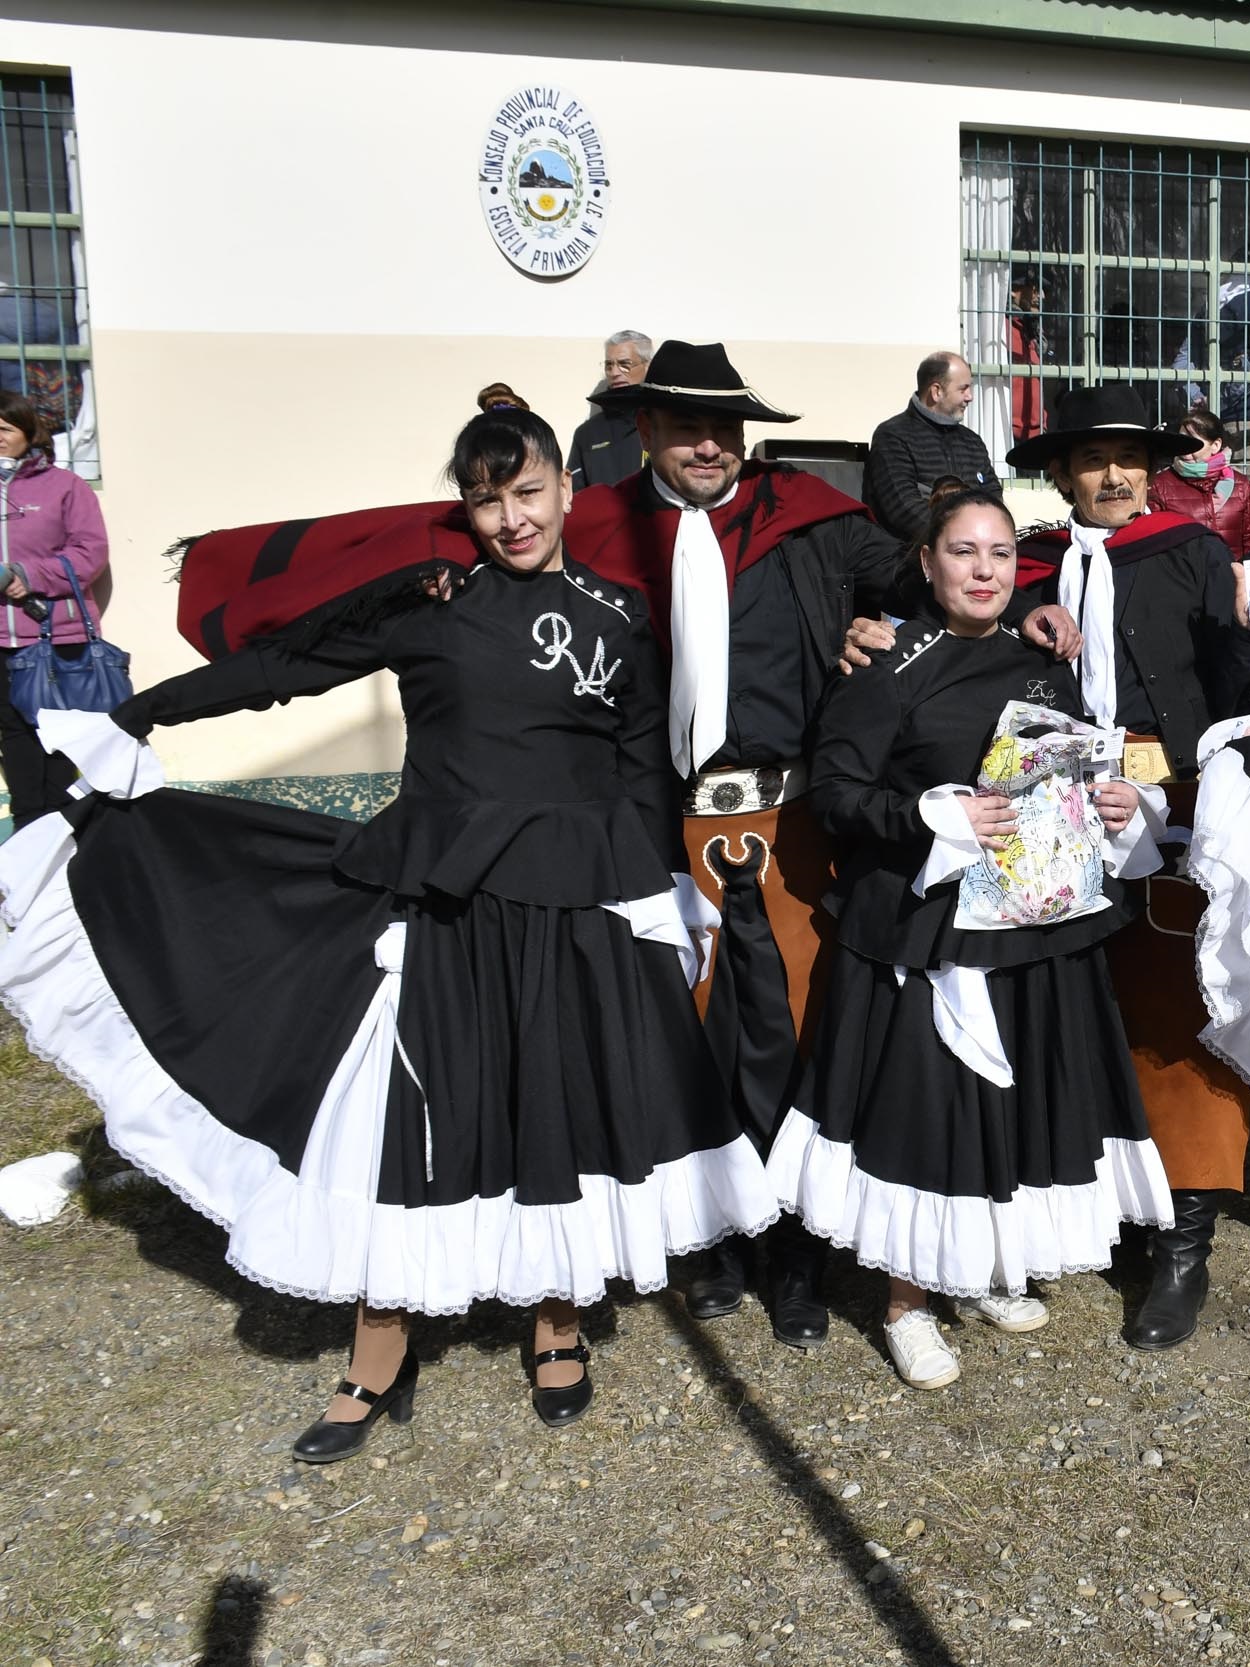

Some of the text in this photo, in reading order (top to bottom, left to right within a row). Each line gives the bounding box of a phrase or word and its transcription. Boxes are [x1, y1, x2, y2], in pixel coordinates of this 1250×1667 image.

[496, 87, 560, 130] PROVINCIAL
[513, 115, 575, 140] SANTA CRUZ
[563, 101, 583, 123] DE
[484, 129, 509, 183] CONSEJO
[489, 204, 527, 258] ESCUELA
[531, 237, 591, 271] PRIMARIA
[586, 200, 603, 218] 37
